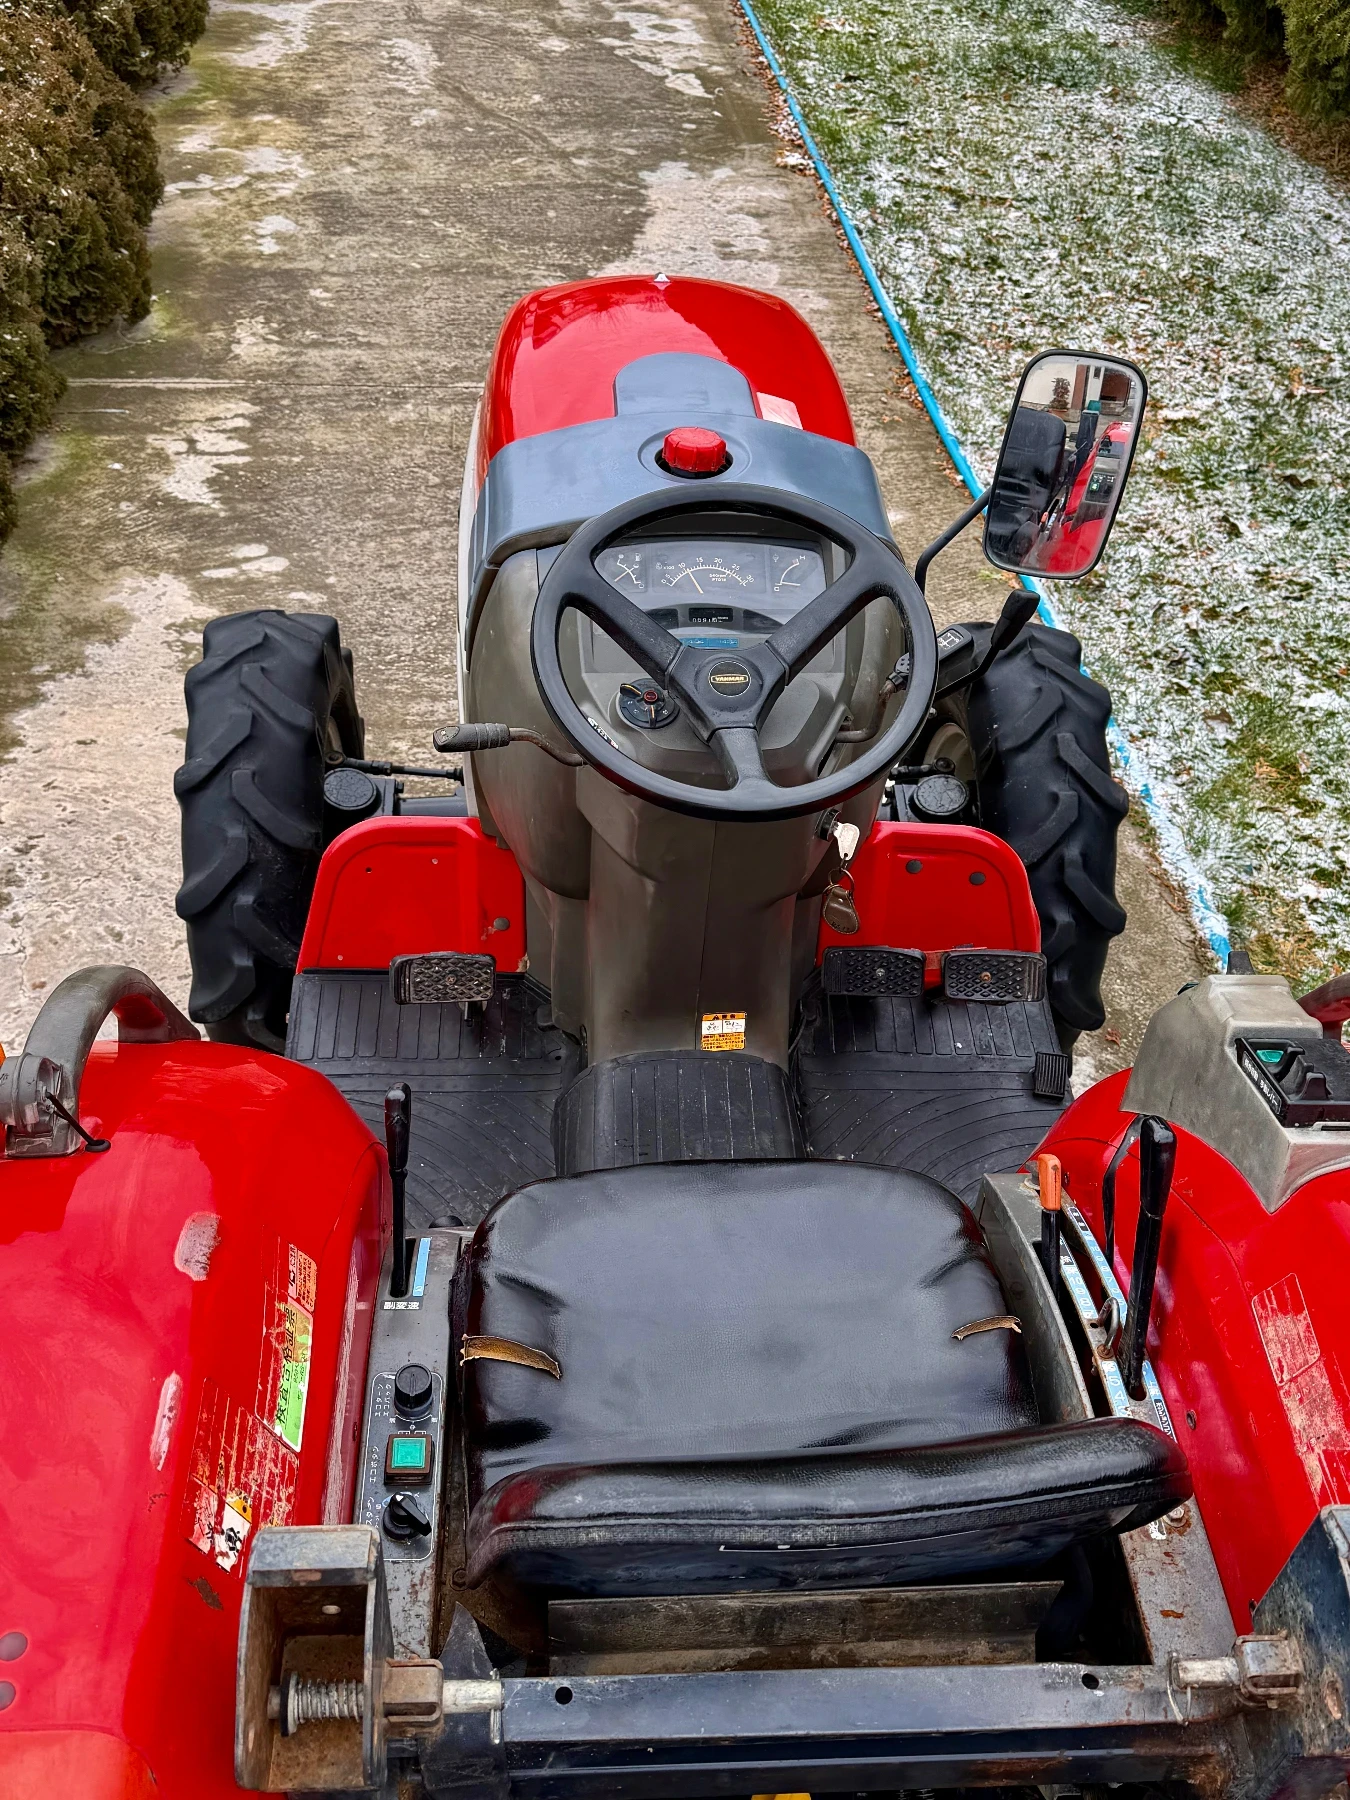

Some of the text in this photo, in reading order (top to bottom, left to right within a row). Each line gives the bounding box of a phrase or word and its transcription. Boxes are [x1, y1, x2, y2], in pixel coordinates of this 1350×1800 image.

[731, 563, 740, 571] 25
[746, 574, 755, 583] 30
[1069, 1276, 1083, 1285] 10
[1076, 1287, 1086, 1295] 9
[1108, 1375, 1121, 1387] 5
[1115, 1390, 1126, 1401] 4
[374, 1383, 384, 1417] エコターン
[383, 1383, 392, 1417] エコバック
[369, 1445, 379, 1484] エコボタン
